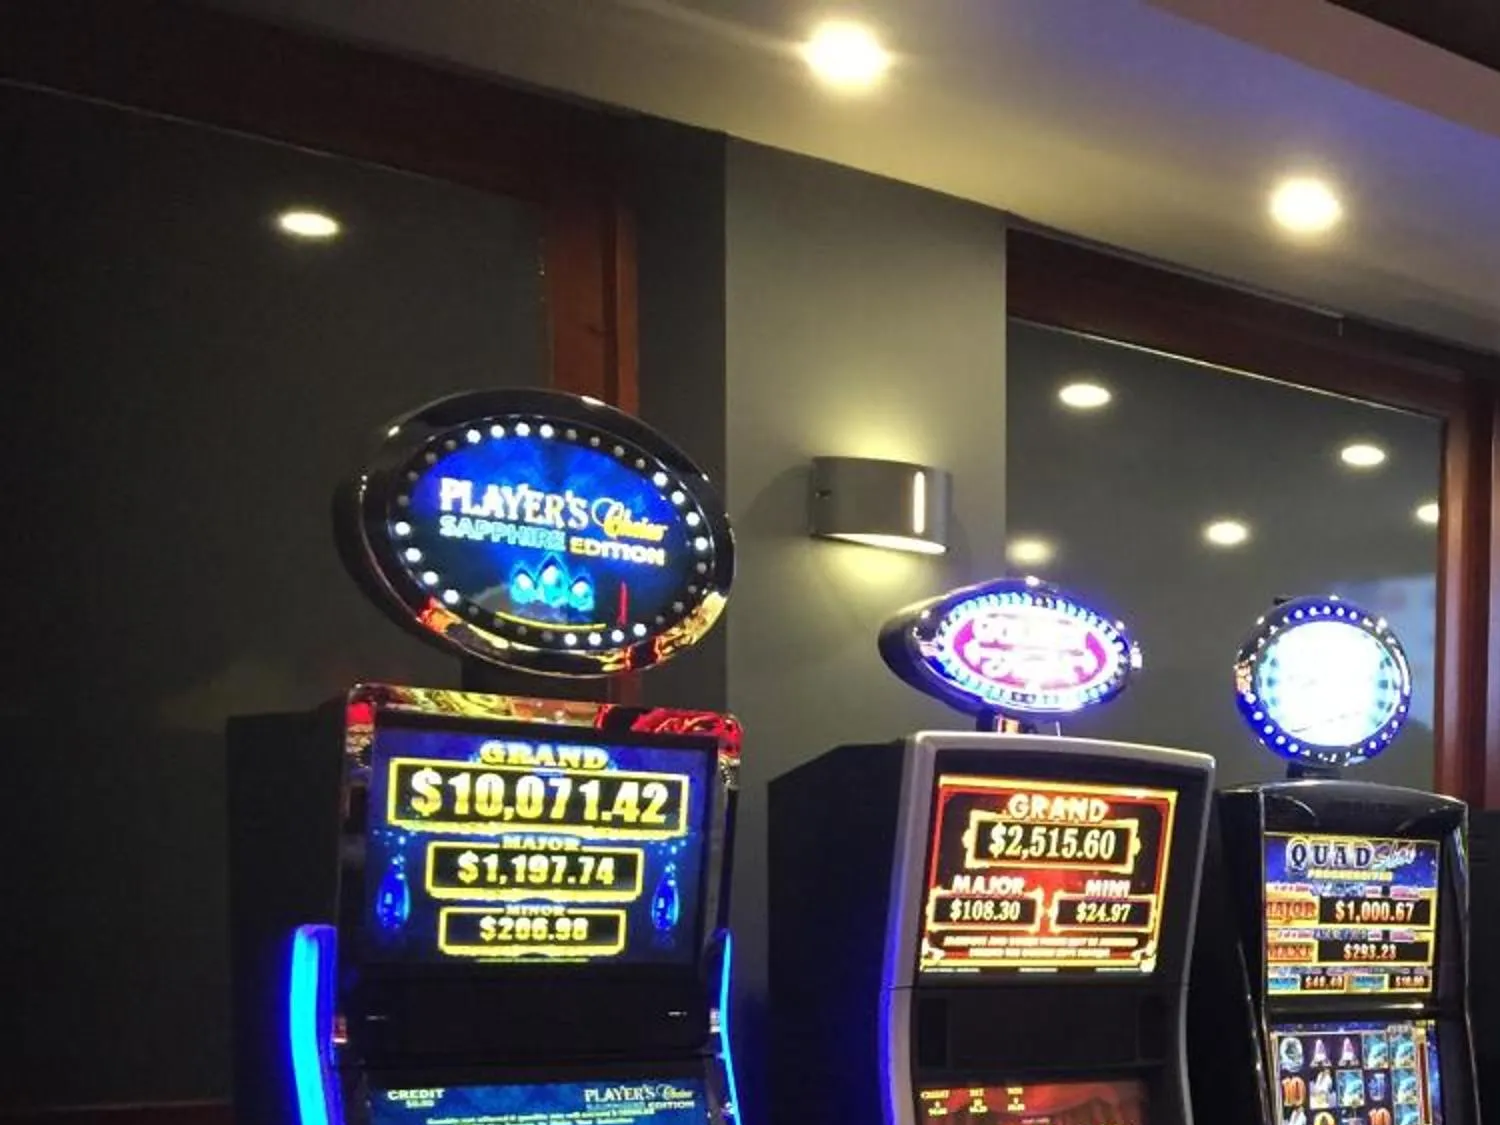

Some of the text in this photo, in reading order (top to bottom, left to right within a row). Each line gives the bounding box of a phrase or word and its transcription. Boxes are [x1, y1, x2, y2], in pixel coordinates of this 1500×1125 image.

[440, 477, 588, 530] PLAYER'S
[439, 515, 665, 566] SAPPHIRE EDITION
[479, 741, 609, 770] GRAND
[411, 767, 669, 824] $10,071.42
[1007, 793, 1109, 822] GRAND
[989, 821, 1116, 860] $2,515.60
[1291, 841, 1371, 868] QUAD
[457, 850, 615, 884] $1,197.74
[952, 875, 1026, 896] MAJOR
[951, 898, 1132, 923] $108.30 $24.97
[1335, 899, 1415, 924] $1,000.67
[387, 1087, 445, 1101] CREDIT
[584, 1084, 655, 1103] PLAYER'S
